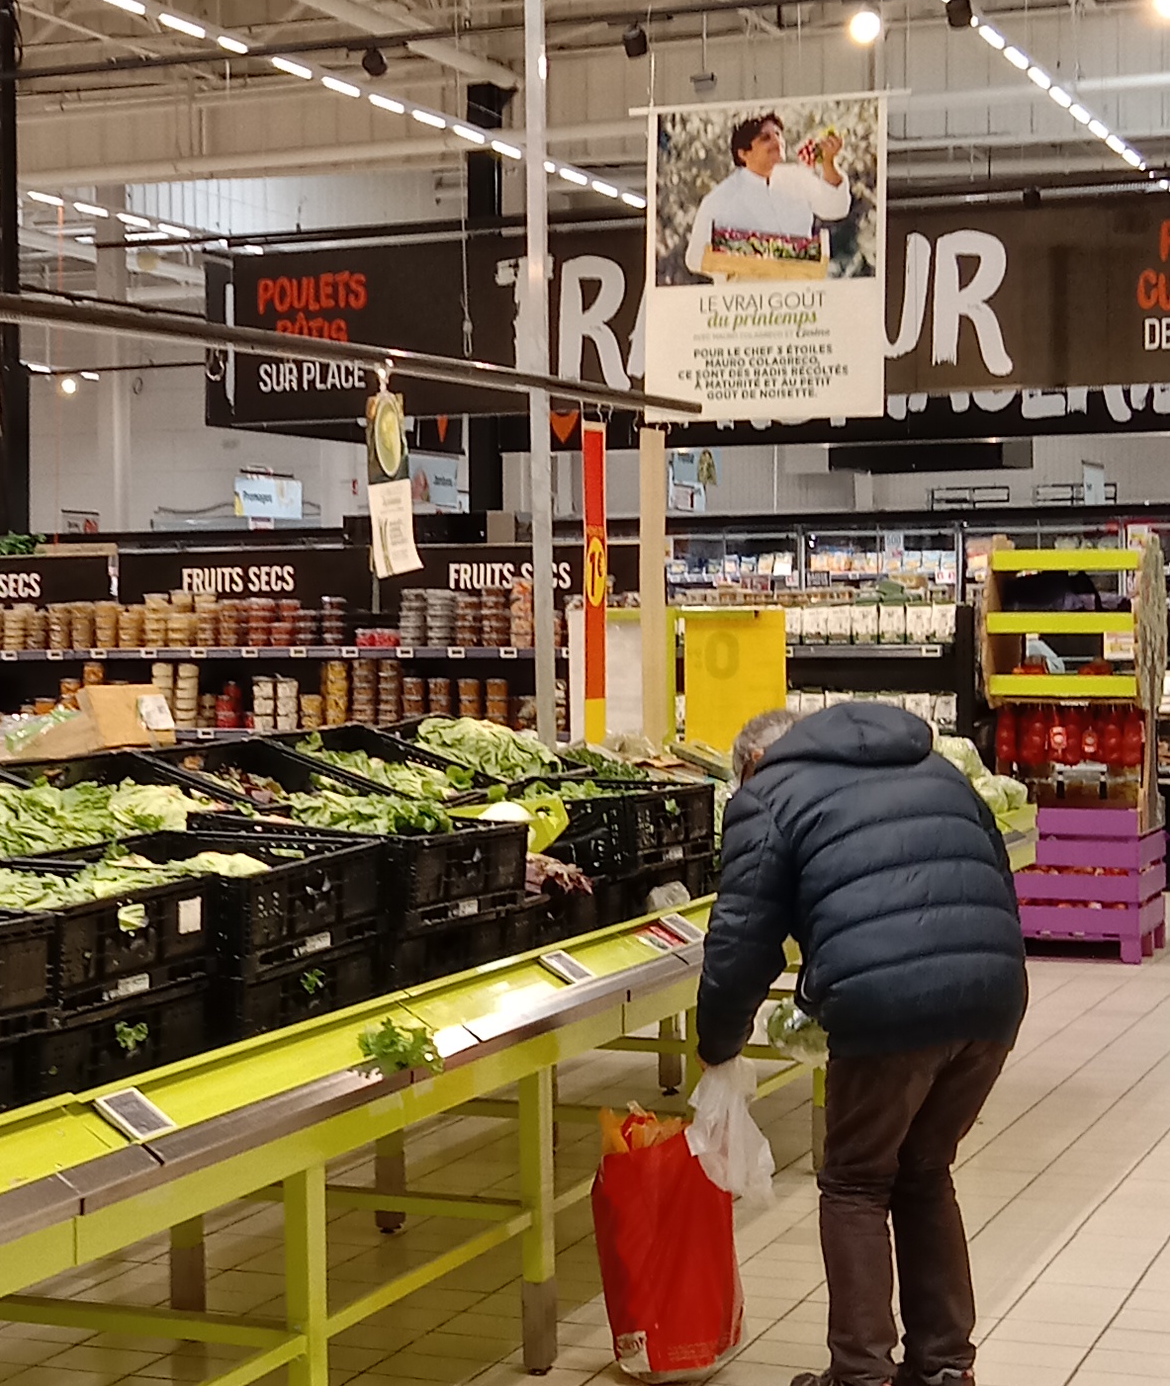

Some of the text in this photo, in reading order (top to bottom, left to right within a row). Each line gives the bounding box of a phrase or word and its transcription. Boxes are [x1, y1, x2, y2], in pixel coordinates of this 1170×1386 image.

[257, 269, 368, 314] POULETS
[699, 286, 826, 313] LE VRAI GOÛT
[707, 309, 818, 334] du printemps
[694, 348, 724, 359] POUR
[727, 347, 740, 356] LE
[744, 345, 773, 356] CHEF
[786, 343, 833, 355] ÉTOILES
[705, 358, 745, 368] MAURO
[259, 360, 367, 393] SUR PLACE
[678, 370, 692, 380] CE
[696, 369, 725, 380] SONT
[729, 368, 750, 378] DES
[791, 364, 848, 376] RÉCOLTÉS
[705, 378, 760, 389] MATURITÉ
[764, 378, 777, 387] ET
[781, 377, 797, 387] AU
[800, 376, 831, 386] PETIT
[741, 389, 756, 399] DE
[181, 565, 295, 595] FRUITS SECS
[448, 562, 572, 590] FRUITS SS
